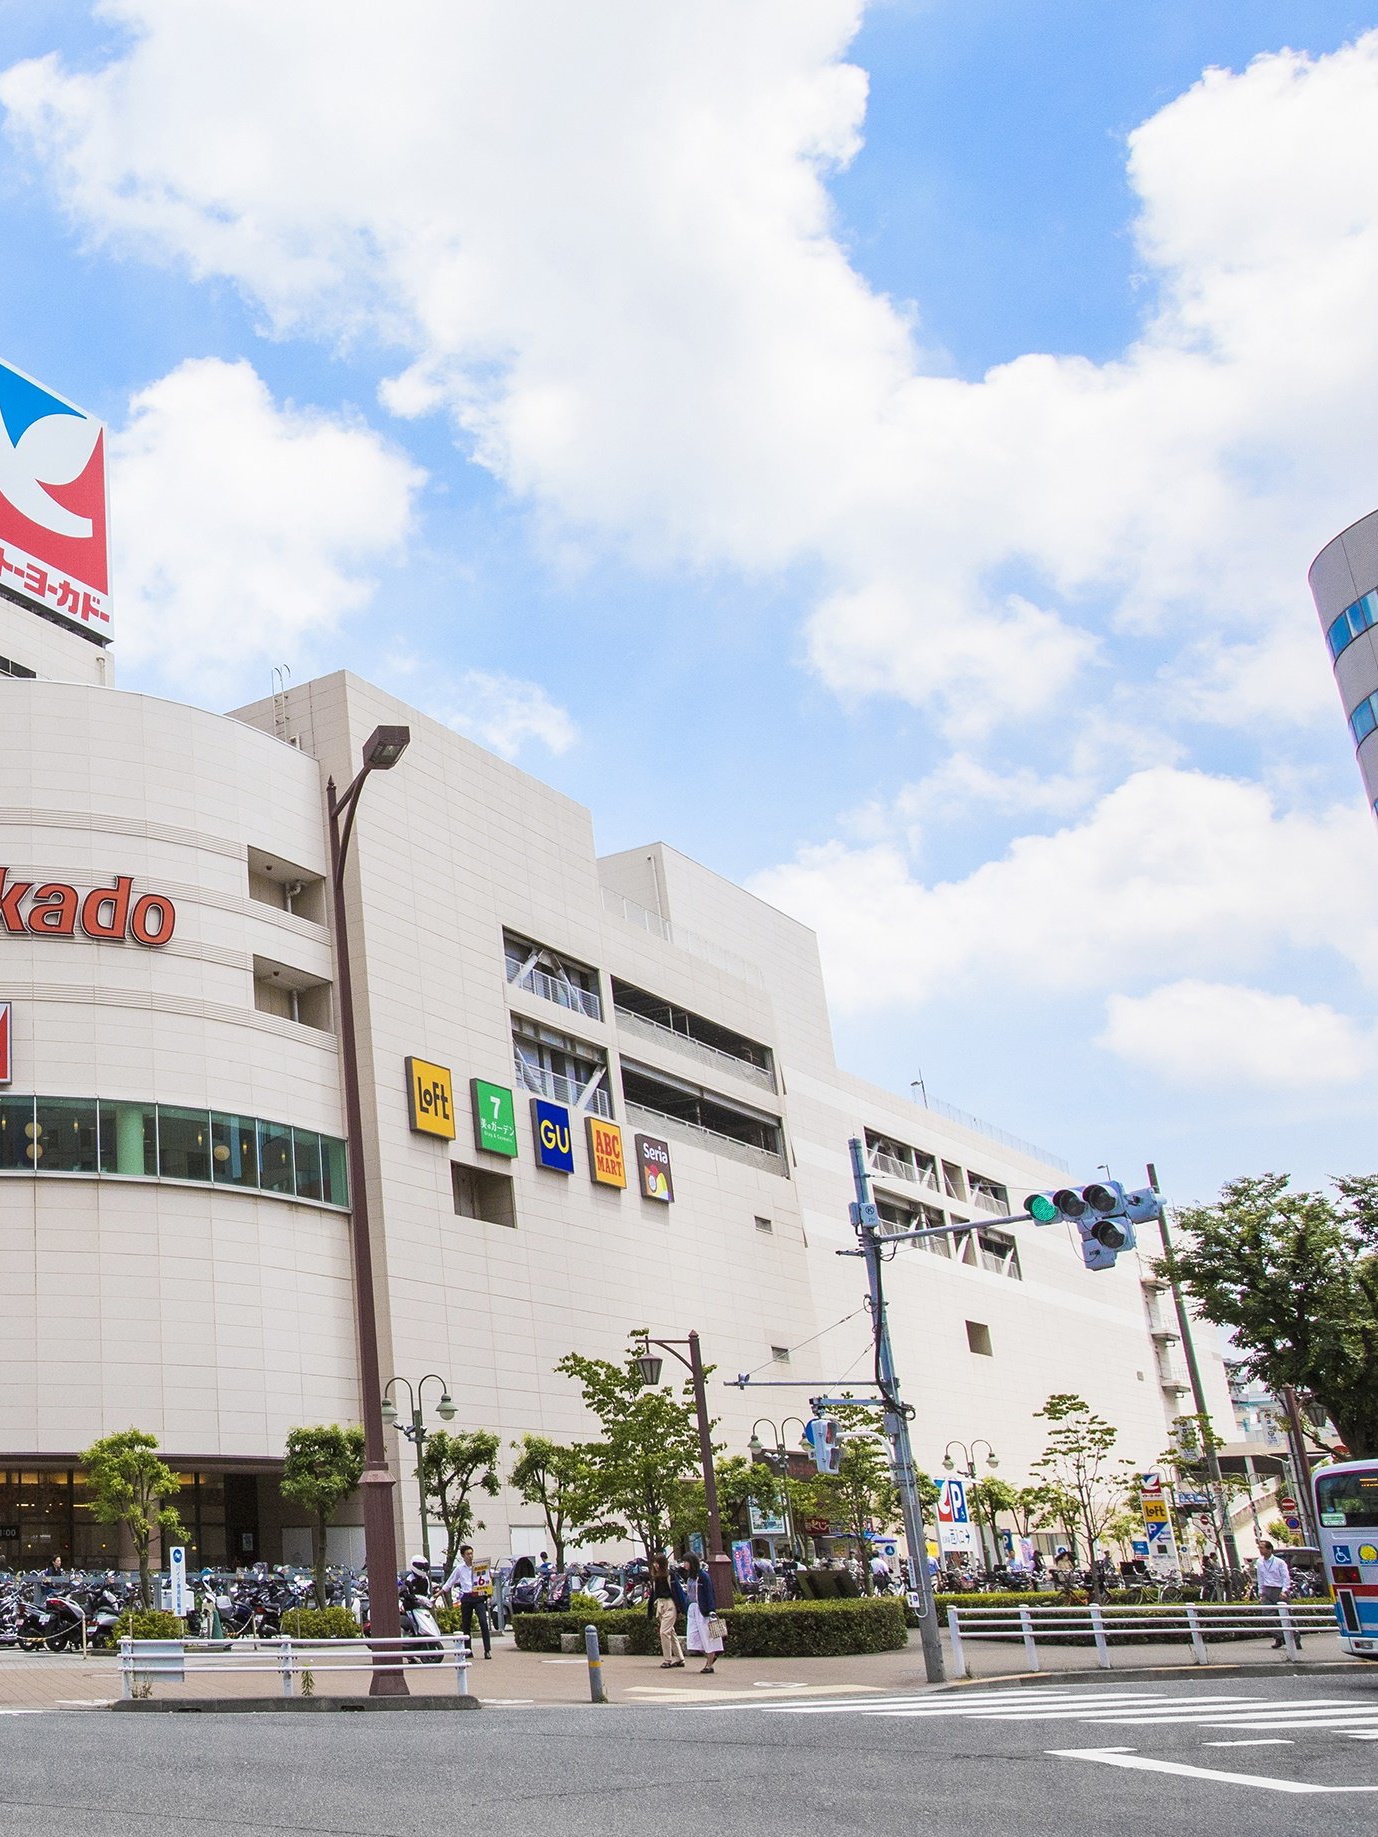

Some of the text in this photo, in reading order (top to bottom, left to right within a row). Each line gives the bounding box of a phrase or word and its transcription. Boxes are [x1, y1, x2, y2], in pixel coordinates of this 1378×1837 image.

[481, 1117, 514, 1136] 美のガーデン
[540, 1119, 571, 1154] GU
[595, 1129, 621, 1159] ABC
[643, 1142, 668, 1165] Seria
[596, 1157, 622, 1178] MART
[951, 1483, 962, 1519] P
[1147, 1523, 1157, 1535] P
